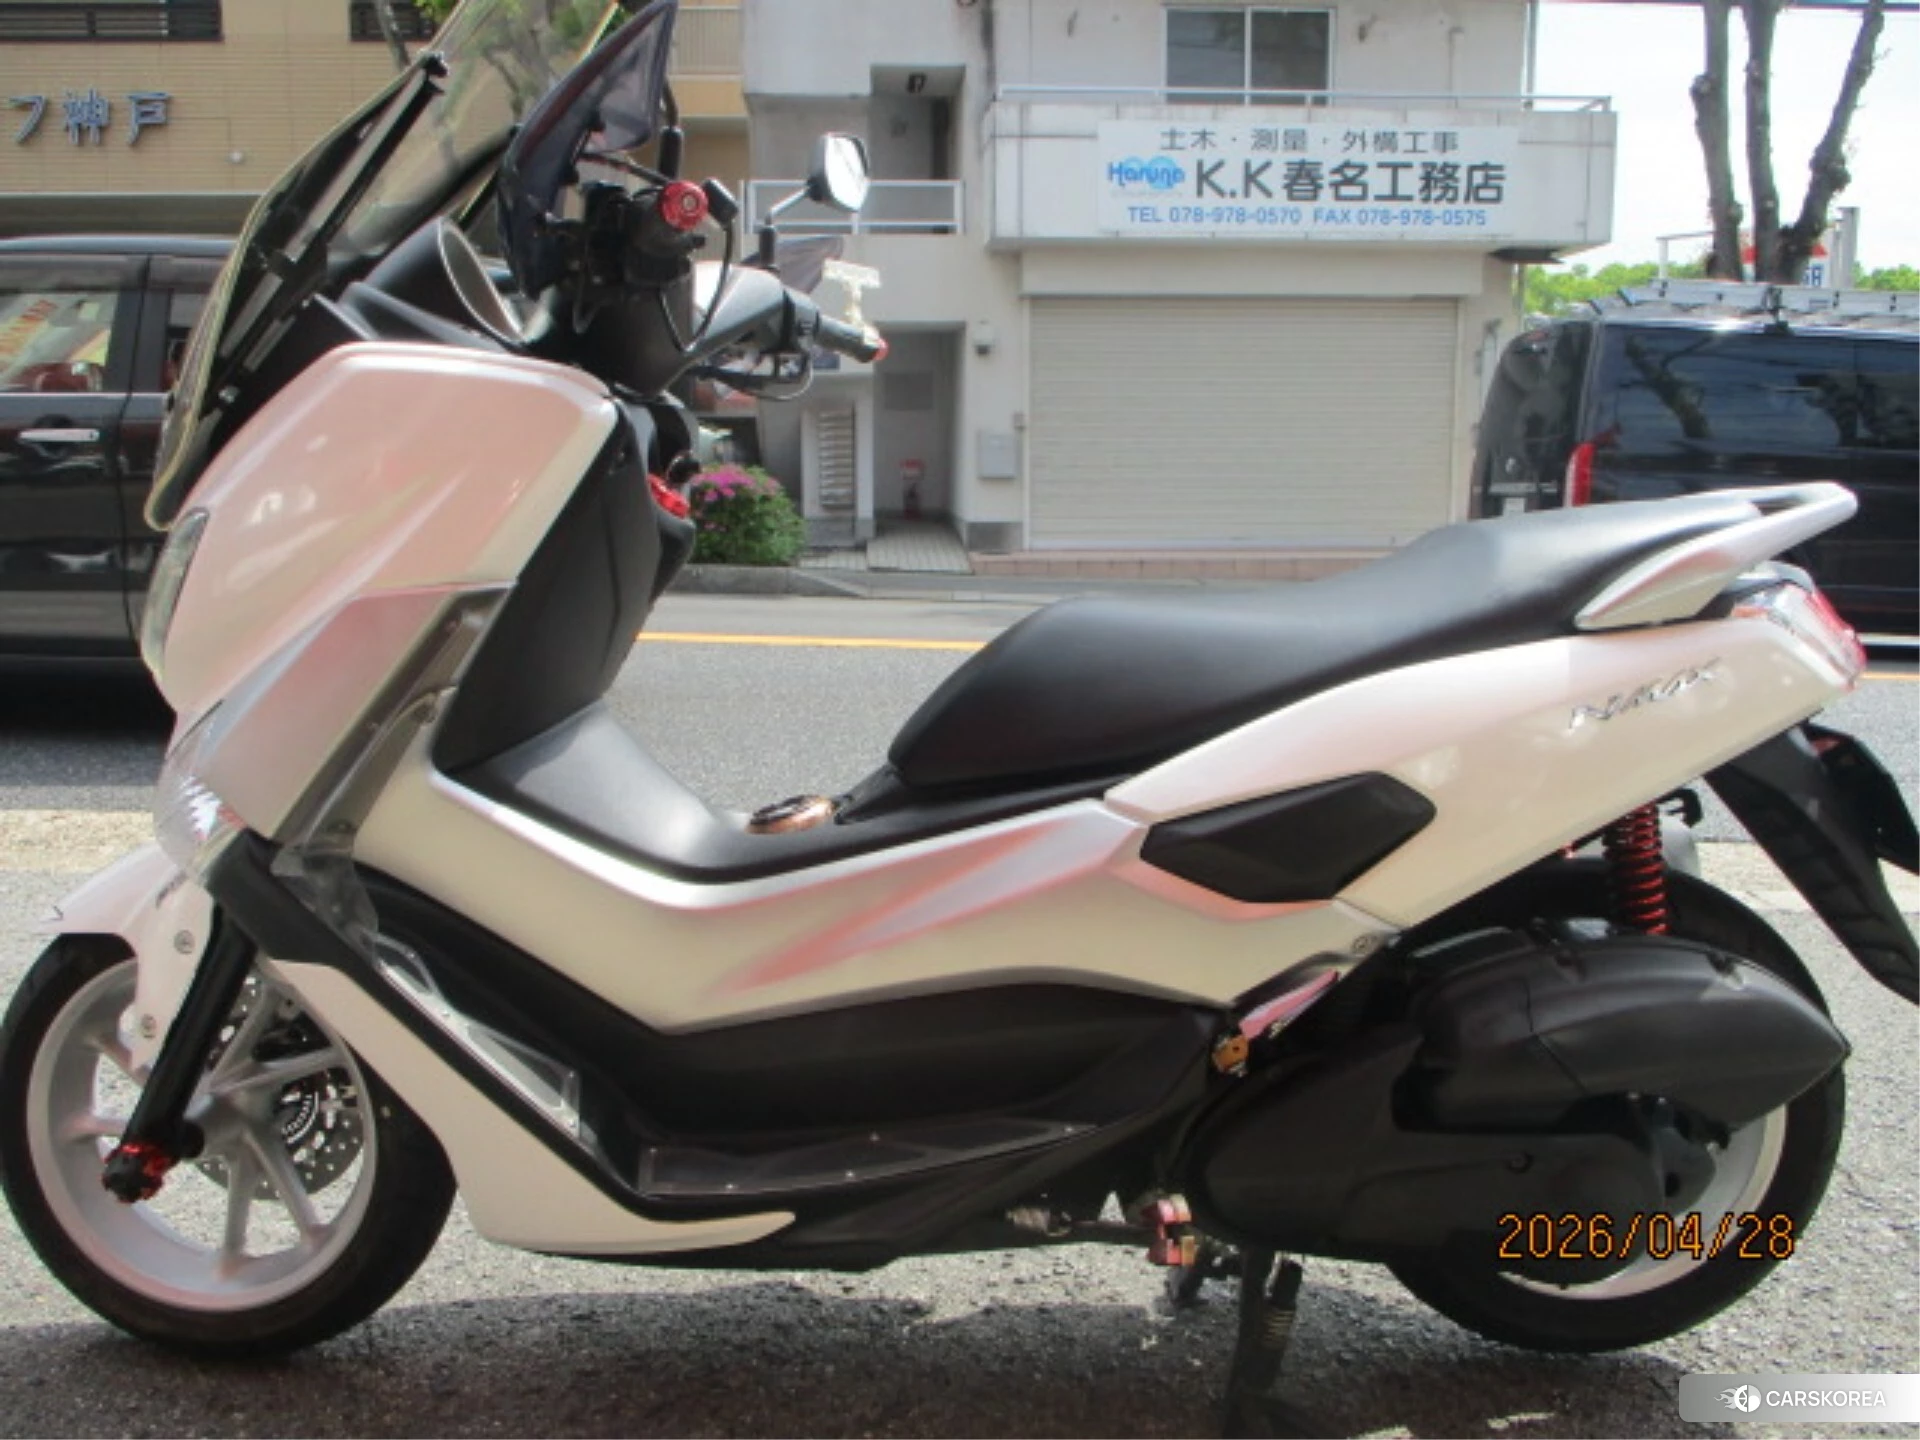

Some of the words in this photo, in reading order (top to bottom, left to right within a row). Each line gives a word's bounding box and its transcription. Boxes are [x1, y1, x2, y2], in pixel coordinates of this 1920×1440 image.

[1128, 206, 1162, 222] TEL
[1169, 206, 1301, 224] 078-978-0570
[1313, 208, 1351, 225] FAX
